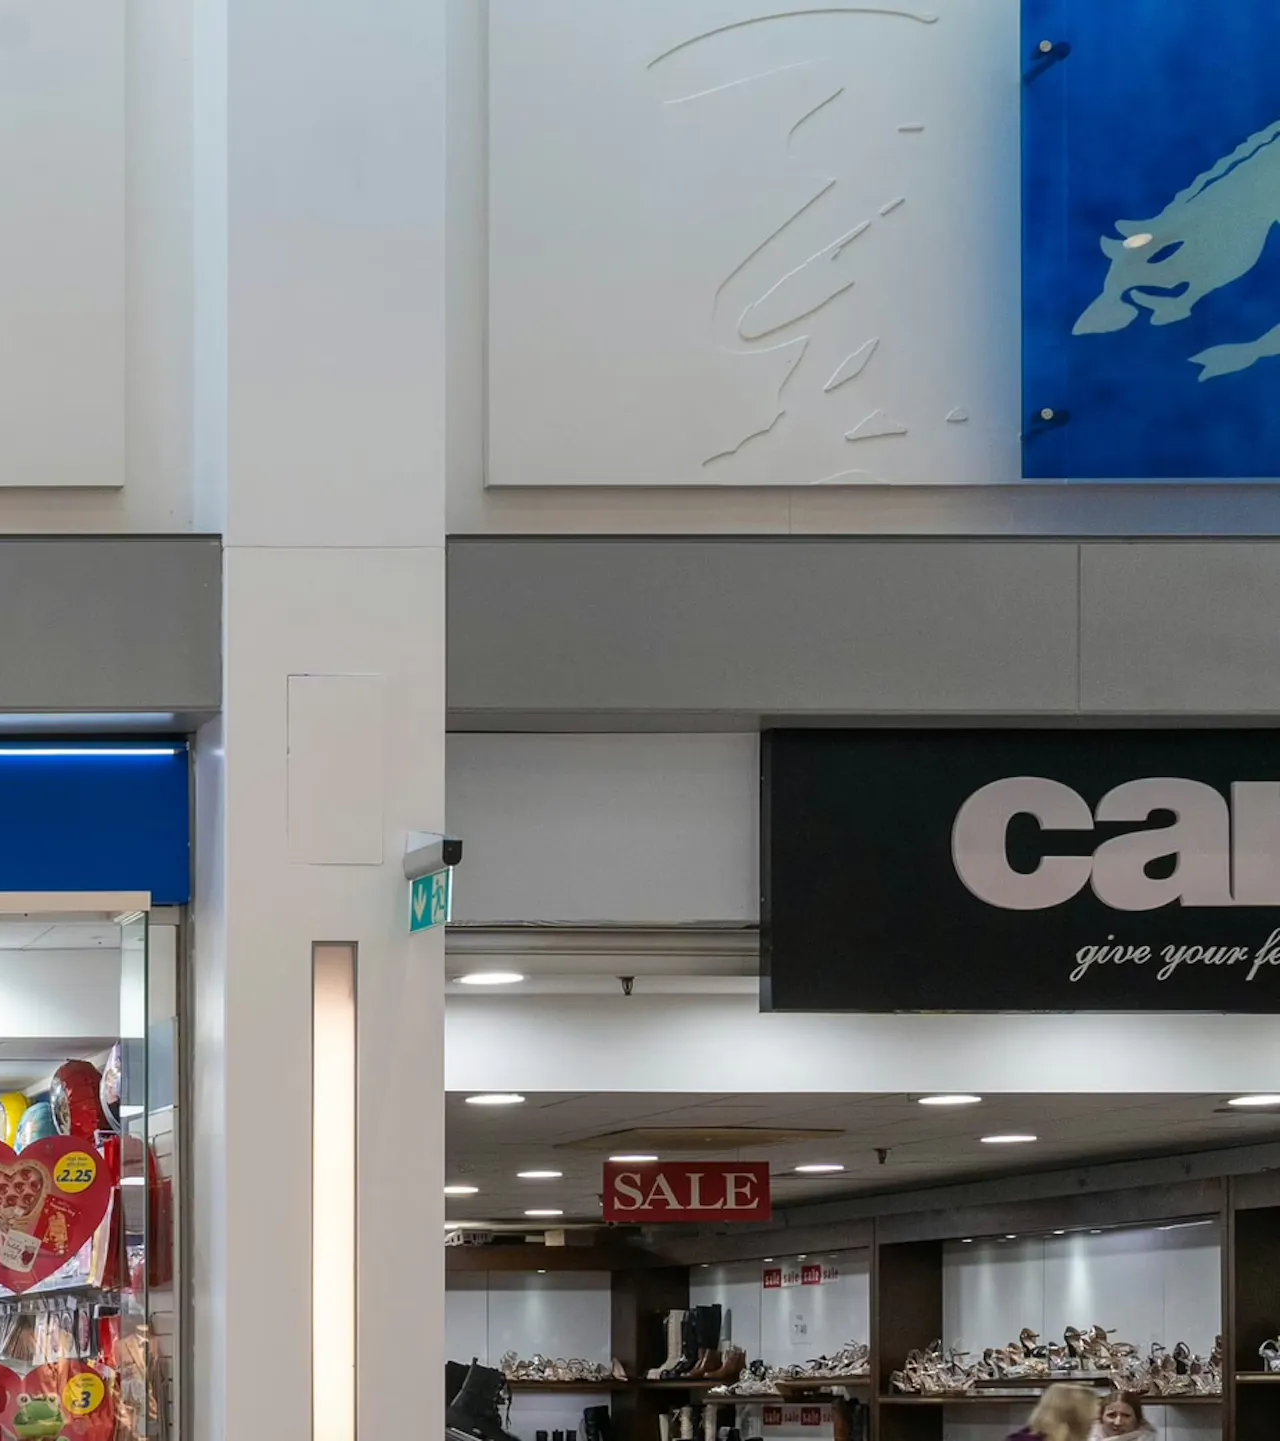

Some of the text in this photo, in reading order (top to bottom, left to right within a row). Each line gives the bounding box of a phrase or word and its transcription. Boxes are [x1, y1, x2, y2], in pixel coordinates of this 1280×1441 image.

[1070, 935, 1152, 982] give
[1156, 942, 1248, 980] your
[614, 1172, 759, 1211] SALE
